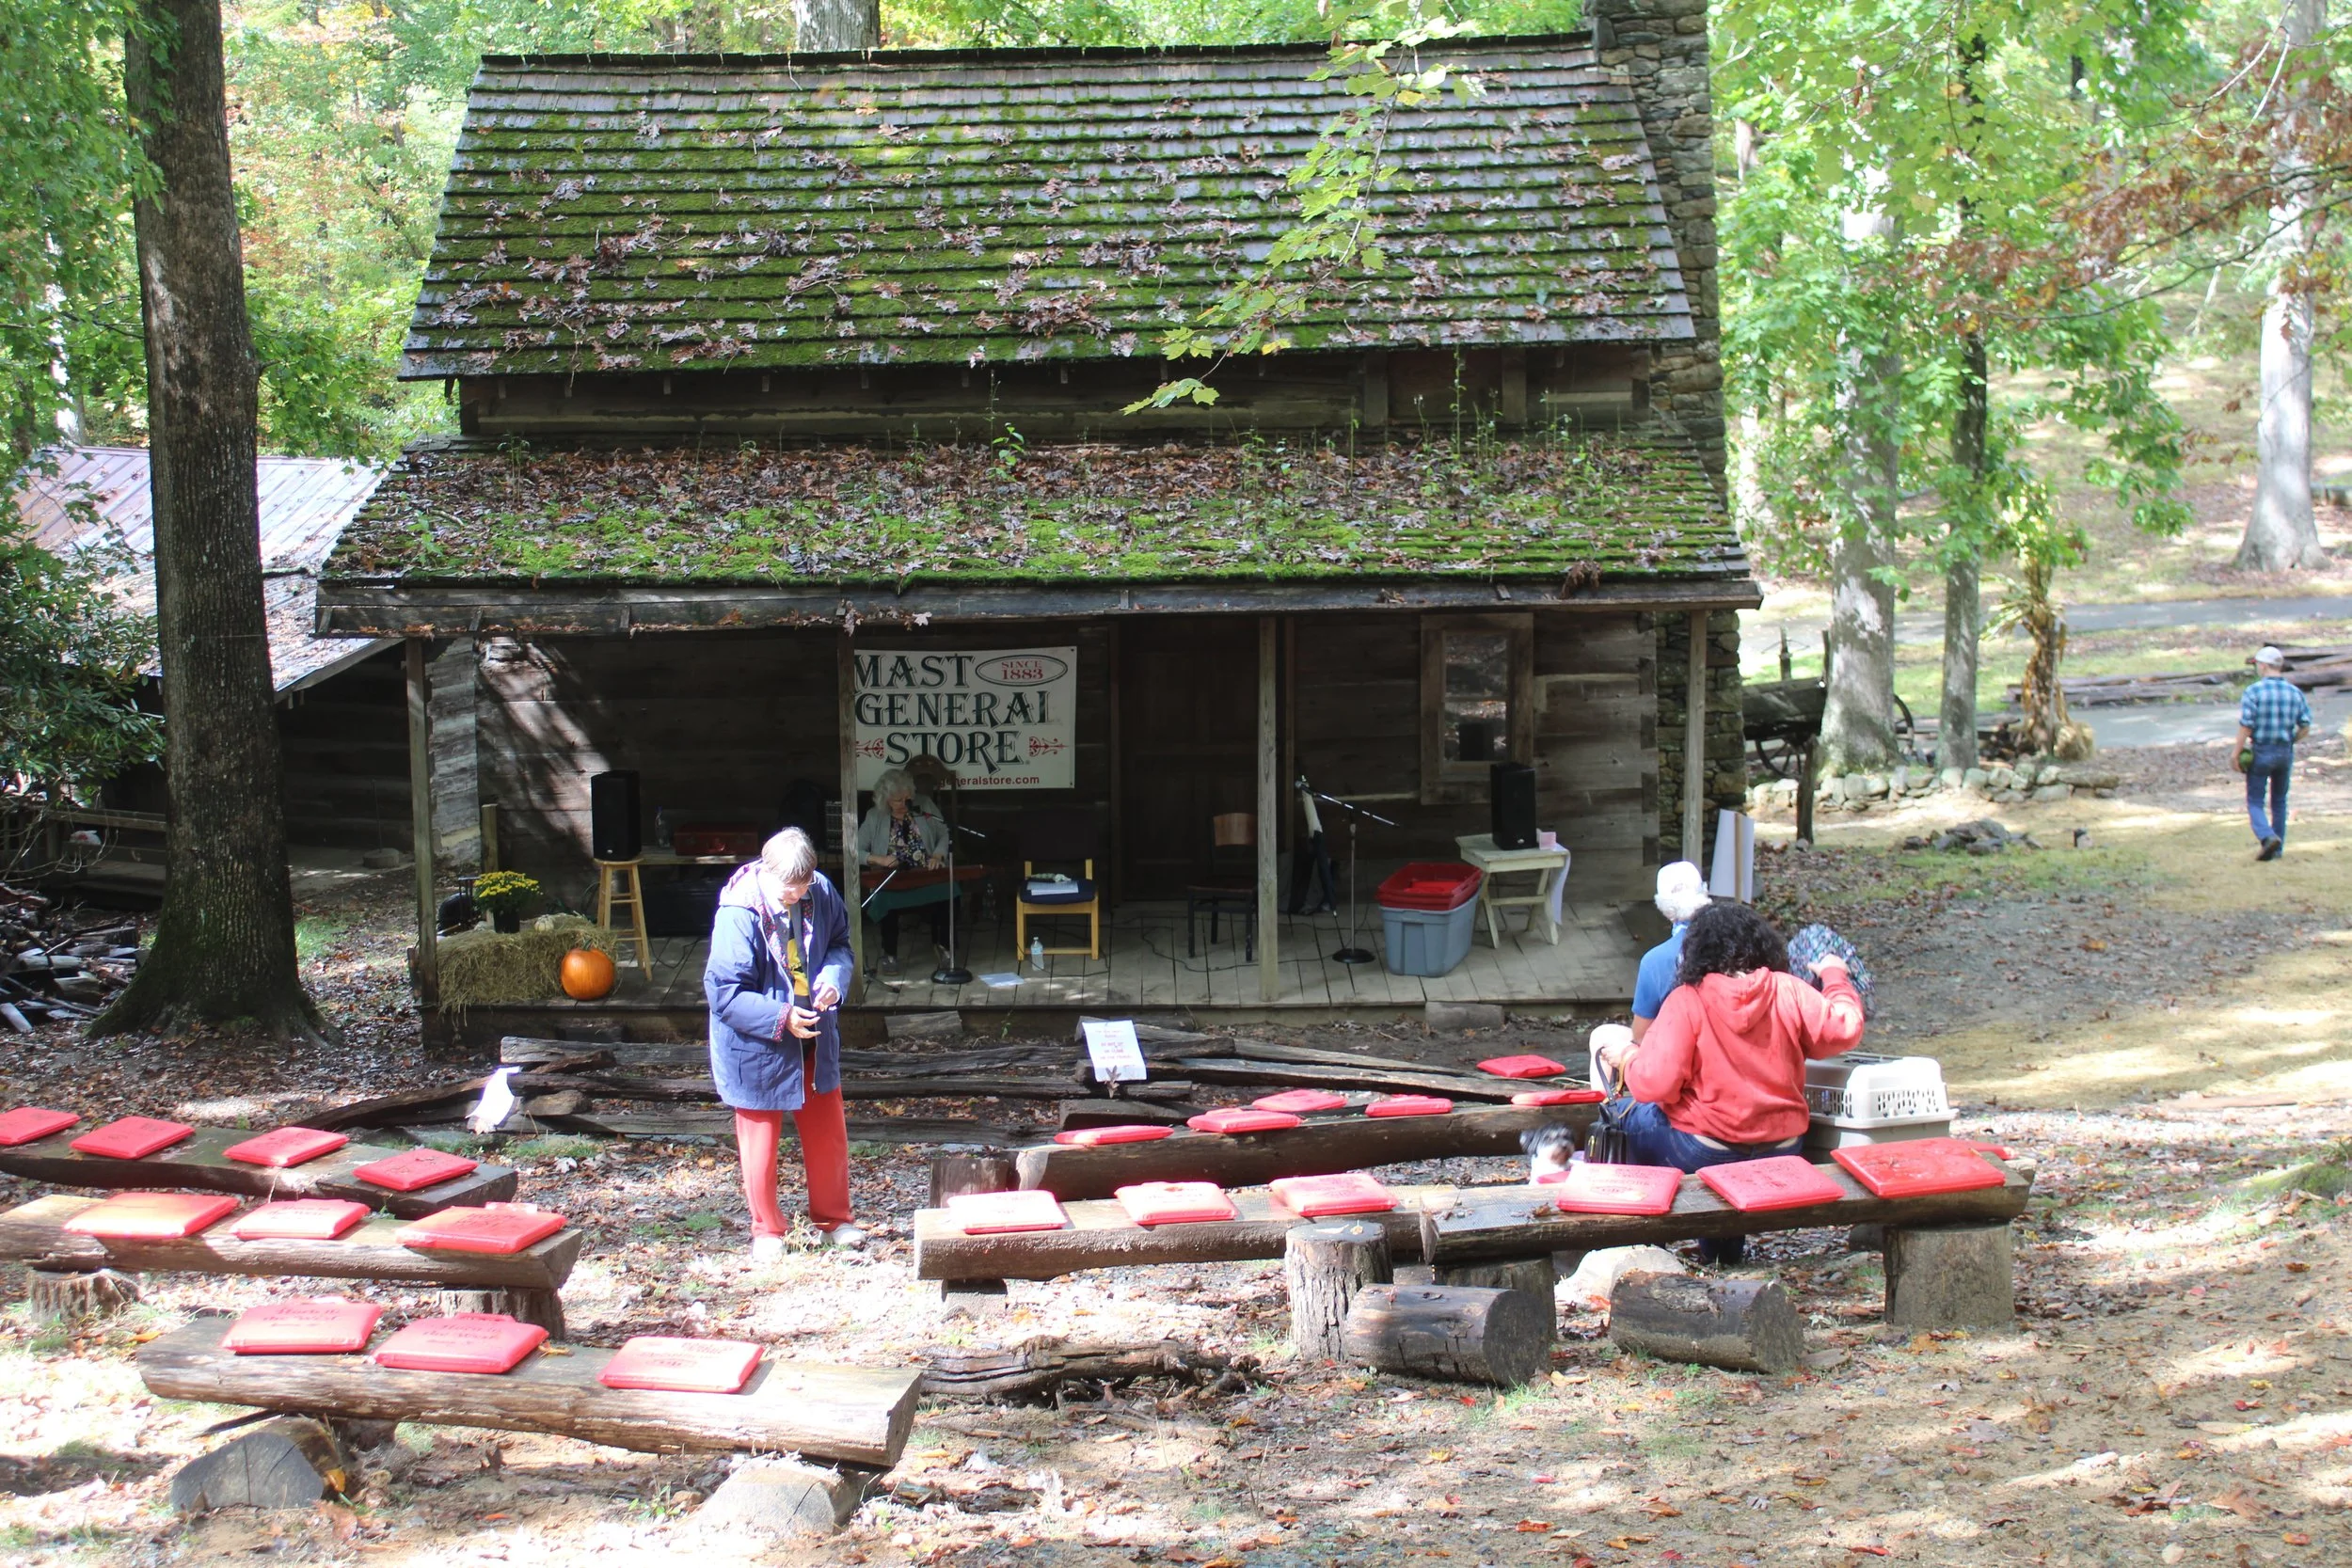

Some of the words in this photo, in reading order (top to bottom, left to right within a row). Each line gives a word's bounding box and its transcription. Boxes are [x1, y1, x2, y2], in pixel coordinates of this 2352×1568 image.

[854, 654, 975, 689] MAST
[1001, 659, 1042, 670] SINCE
[1001, 669, 1043, 680] 1883
[855, 690, 1054, 728] GENERAL
[885, 731, 1024, 774] STORE
